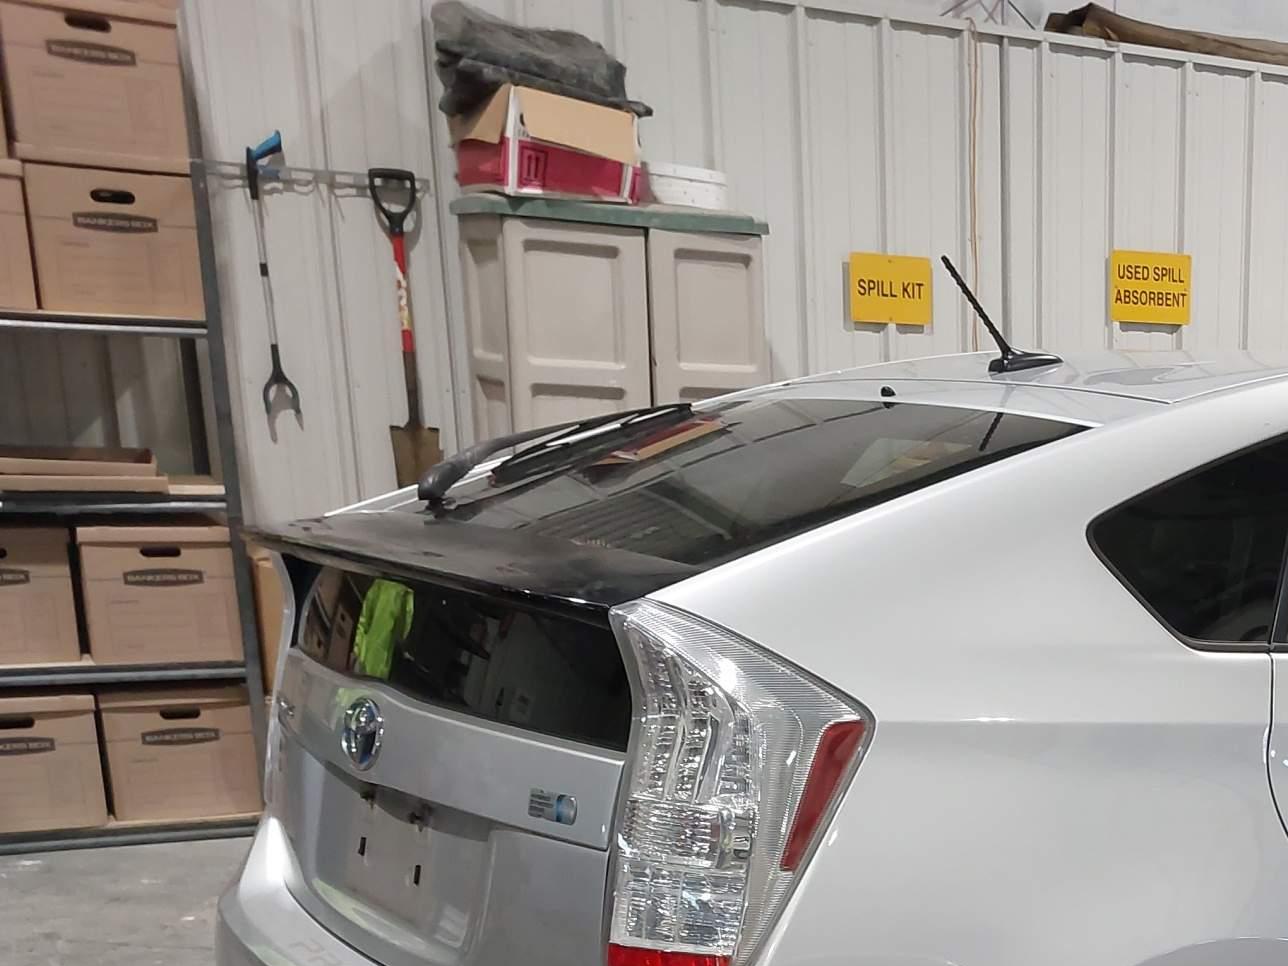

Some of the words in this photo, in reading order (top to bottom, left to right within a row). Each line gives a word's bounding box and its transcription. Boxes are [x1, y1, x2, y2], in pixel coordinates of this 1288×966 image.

[1117, 263, 1150, 281] USED
[1152, 266, 1185, 284] SPILL
[857, 278, 898, 298] SPILL
[902, 281, 924, 299] KIT
[1114, 288, 1188, 308] ABSORBENT
